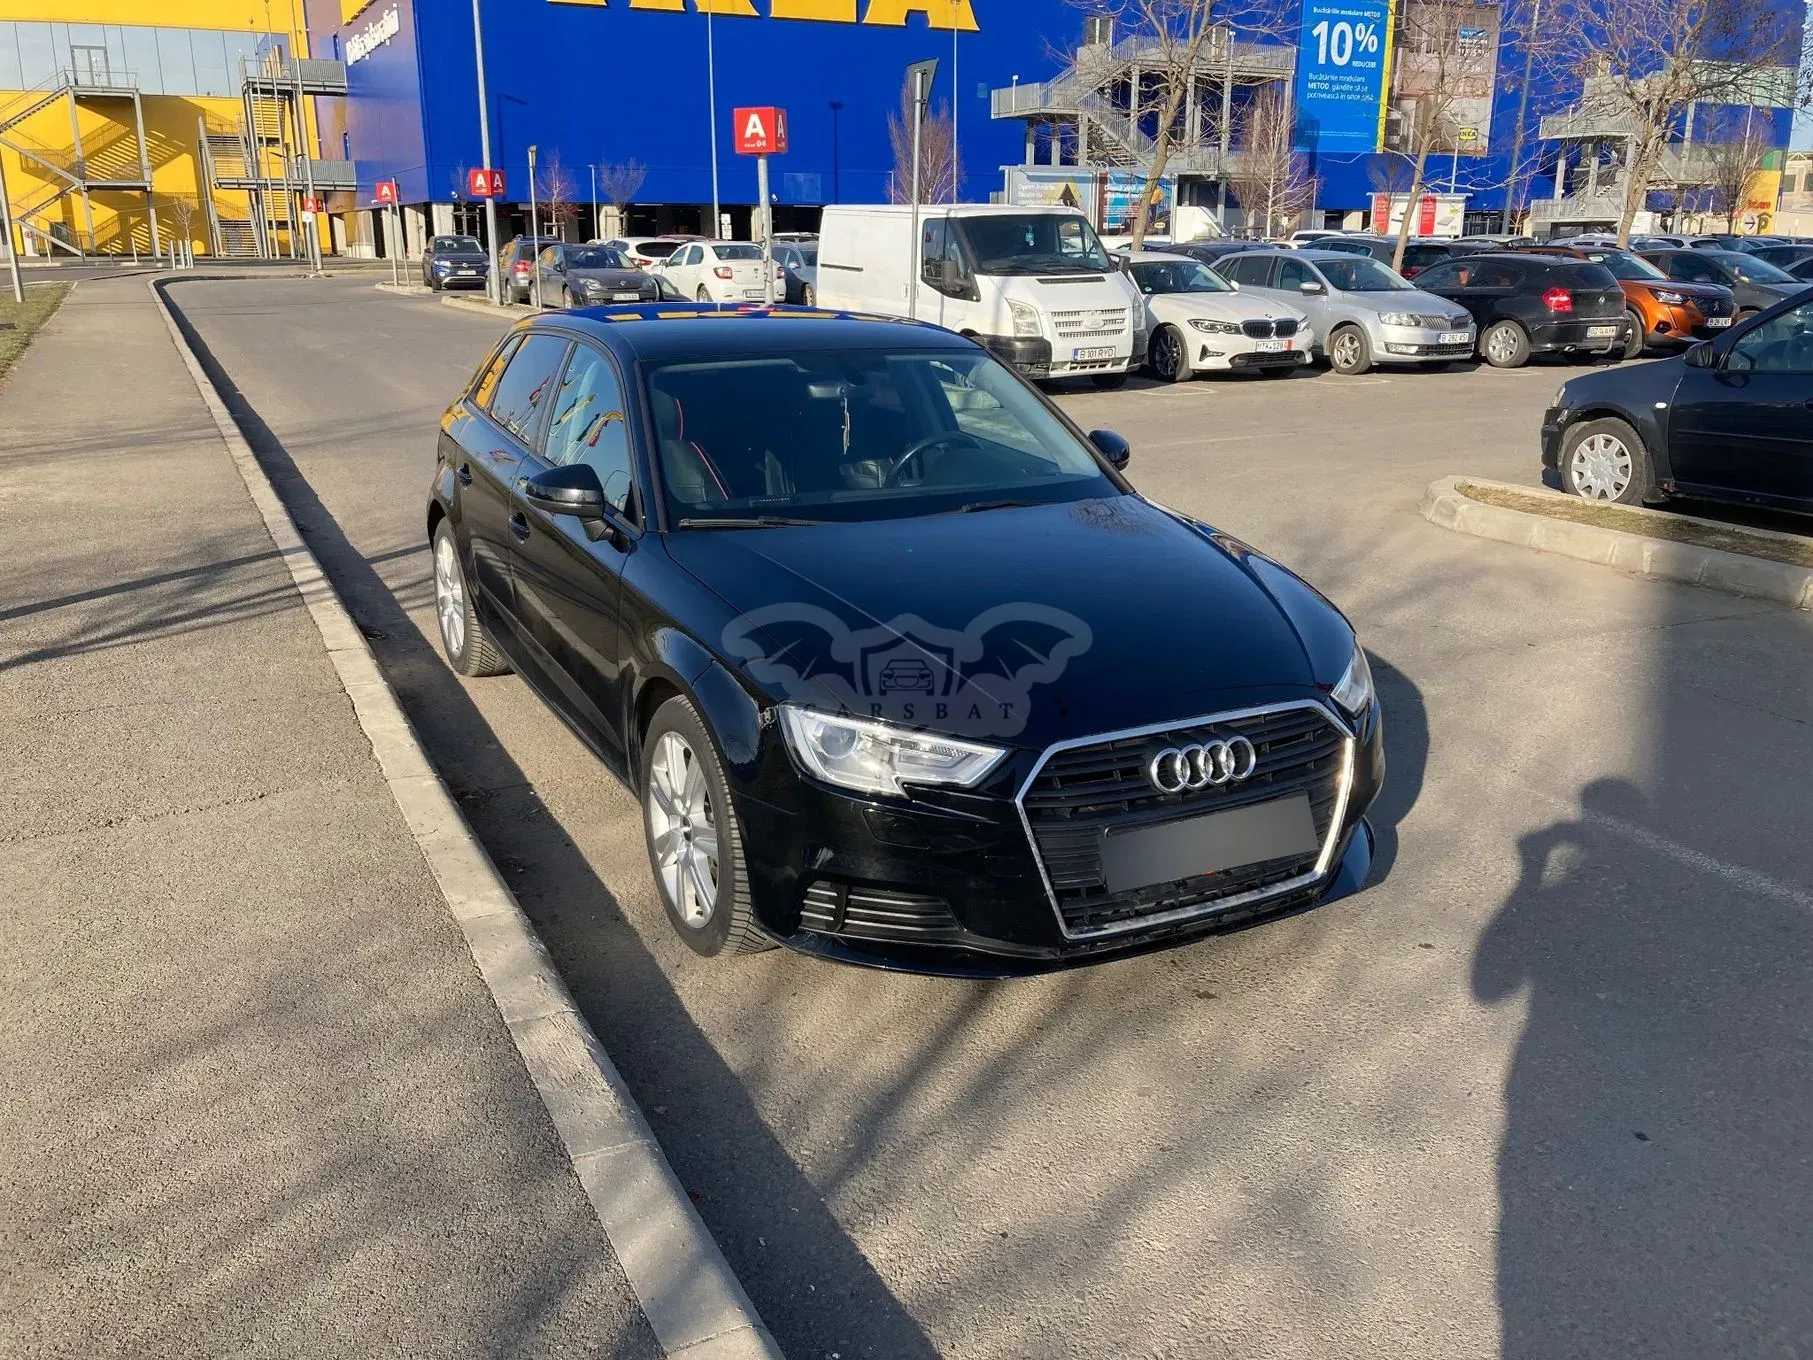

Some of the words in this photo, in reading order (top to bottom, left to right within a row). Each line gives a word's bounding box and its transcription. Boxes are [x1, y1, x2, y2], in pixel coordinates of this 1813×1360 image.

[1311, 20, 1378, 67] 10%
[1352, 60, 1377, 68] REDUCERE
[744, 113, 767, 138] A
[777, 114, 785, 138] A
[475, 173, 487, 188] A
[493, 173, 503, 188] A
[381, 185, 391, 197] A
[307, 199, 315, 208] A
[1080, 350, 1086, 359] B
[1087, 349, 1097, 359] 101
[1098, 348, 1114, 358] RYD
